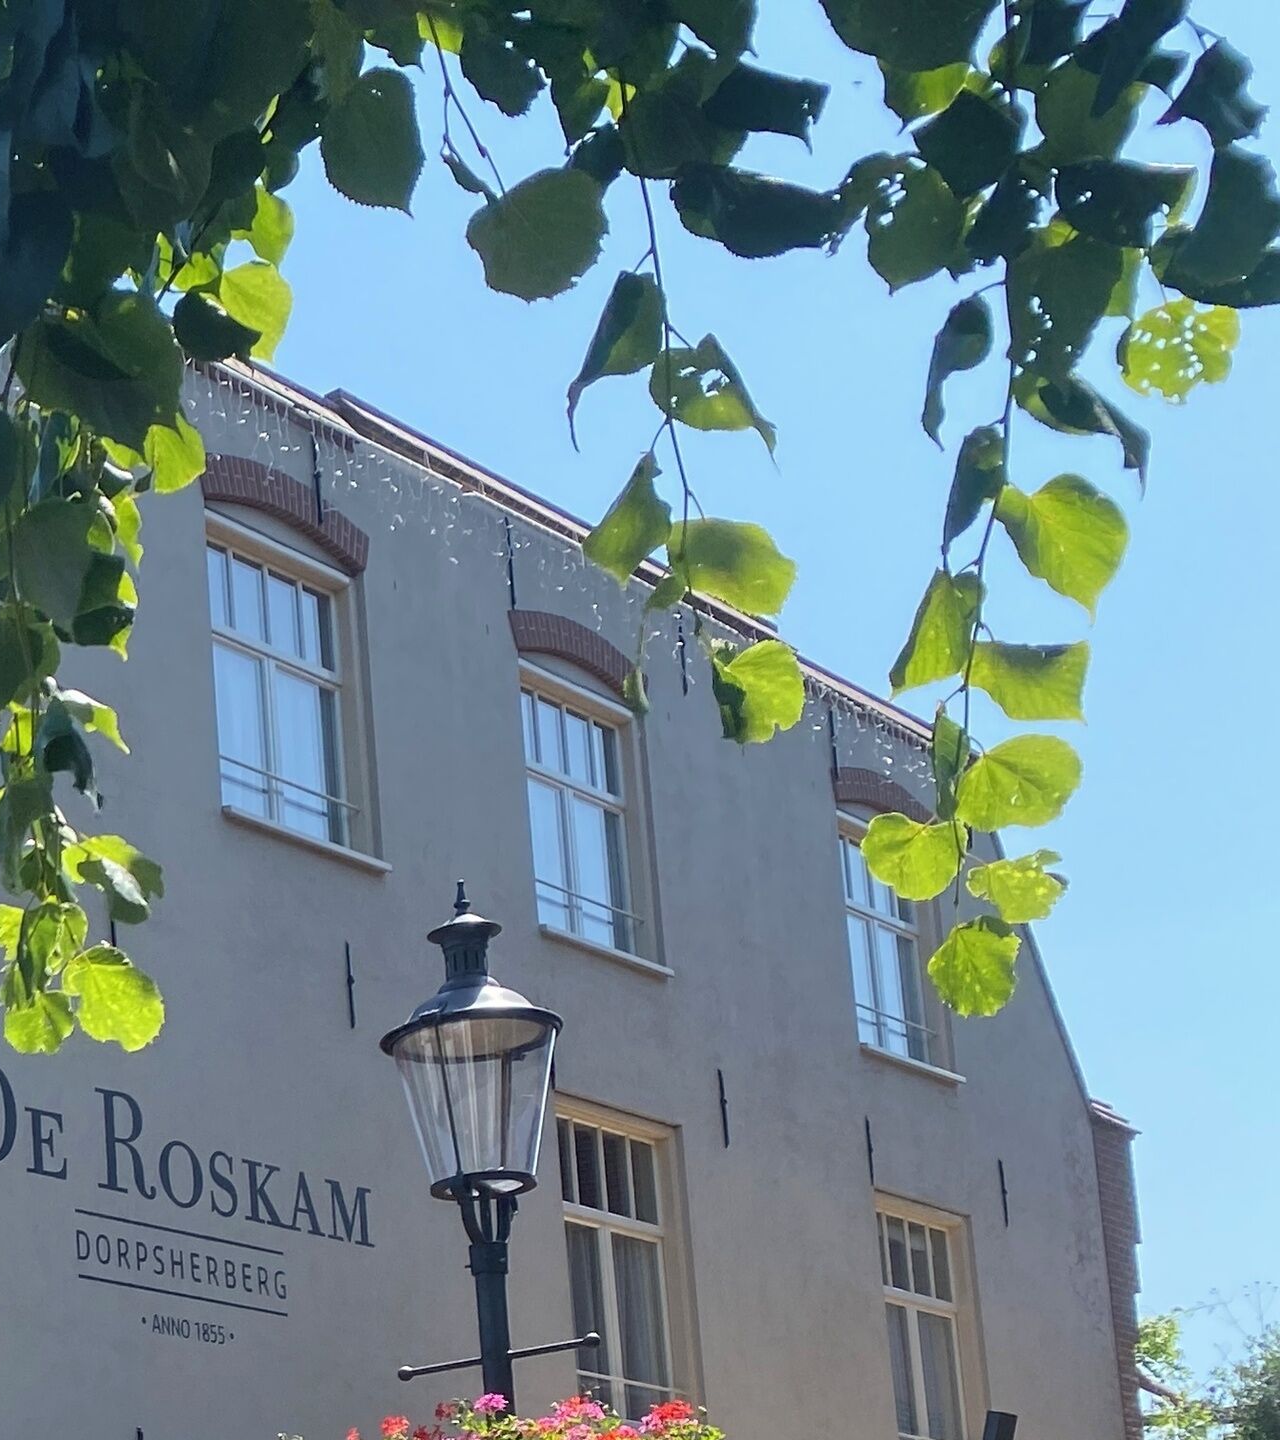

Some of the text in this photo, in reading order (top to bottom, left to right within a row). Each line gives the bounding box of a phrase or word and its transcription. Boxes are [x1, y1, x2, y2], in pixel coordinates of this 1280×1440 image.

[75, 1229, 289, 1301] DORPSHERBERG
[151, 1313, 226, 1346] ANNO 1855
